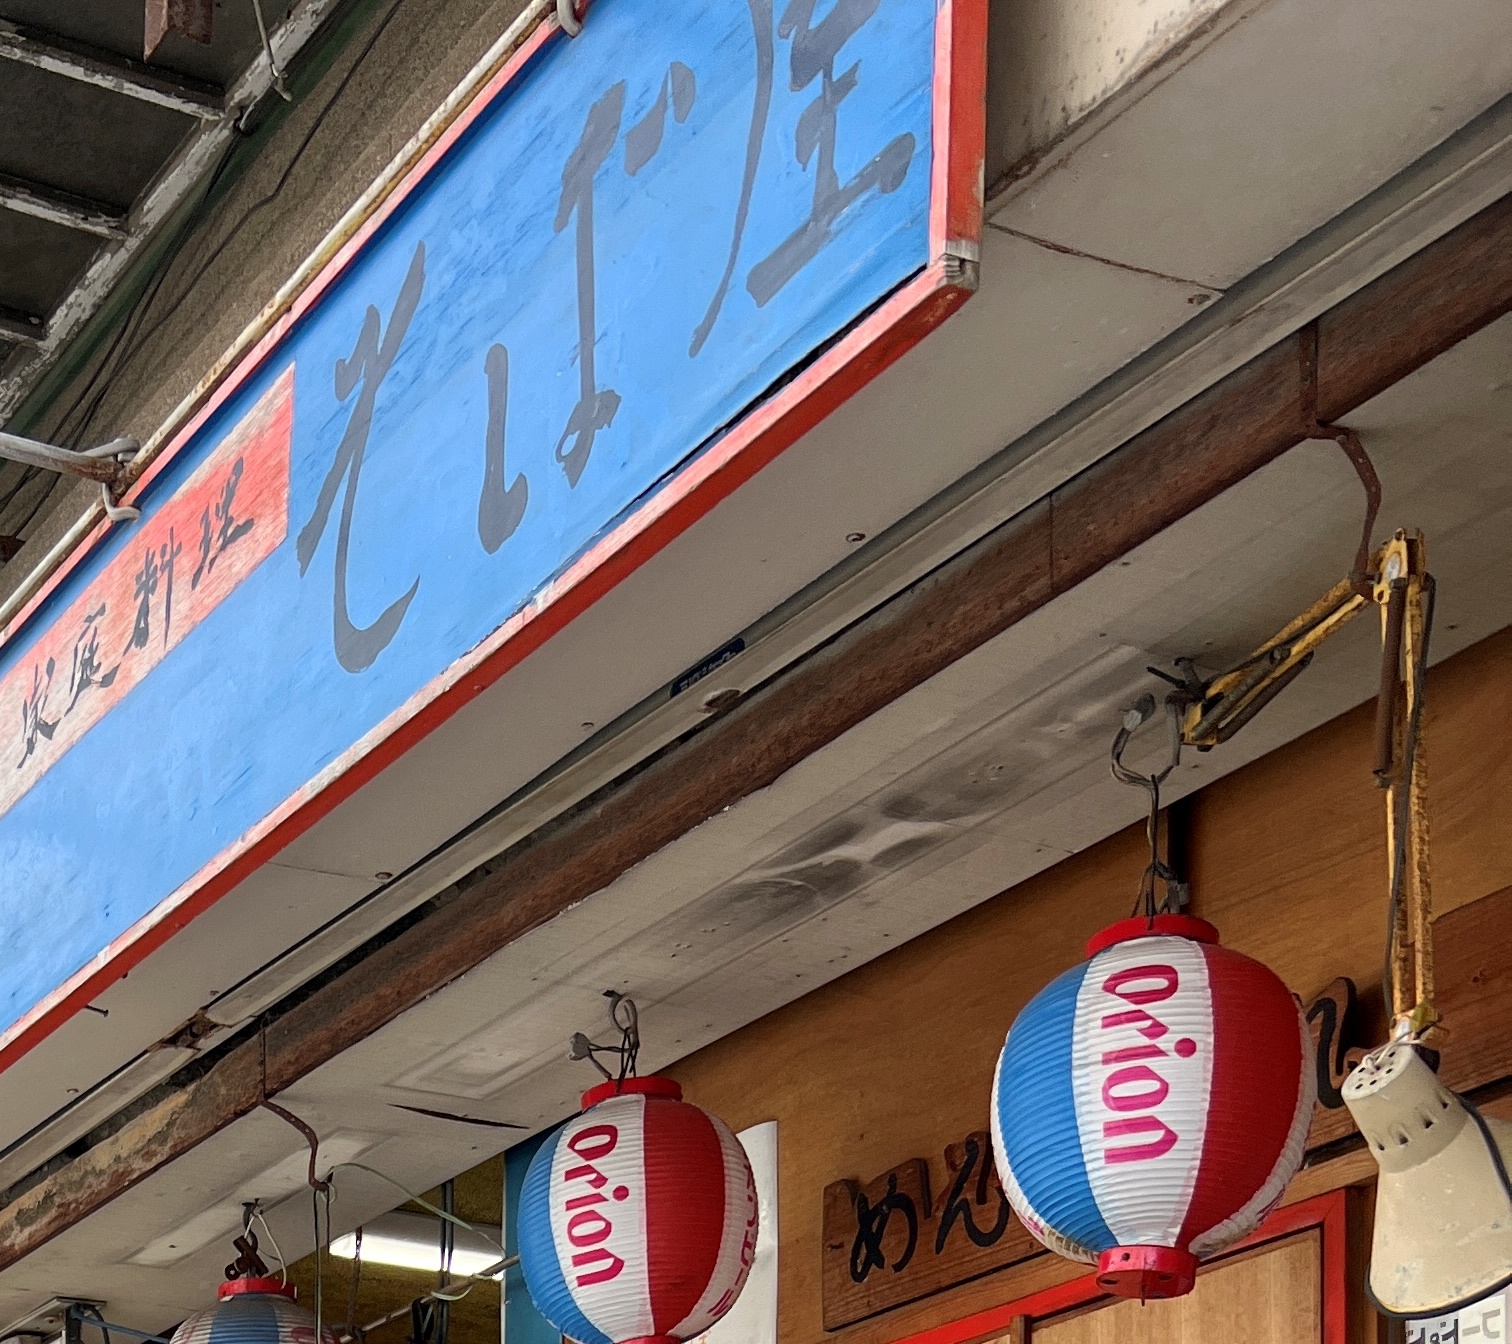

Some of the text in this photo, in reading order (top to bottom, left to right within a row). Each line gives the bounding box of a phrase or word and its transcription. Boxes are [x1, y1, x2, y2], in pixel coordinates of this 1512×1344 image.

[298, 0, 916, 674] そば屋
[16, 456, 255, 770] 家庭料理
[1101, 964, 1197, 1165] Orion
[564, 1124, 630, 1288] Orion
